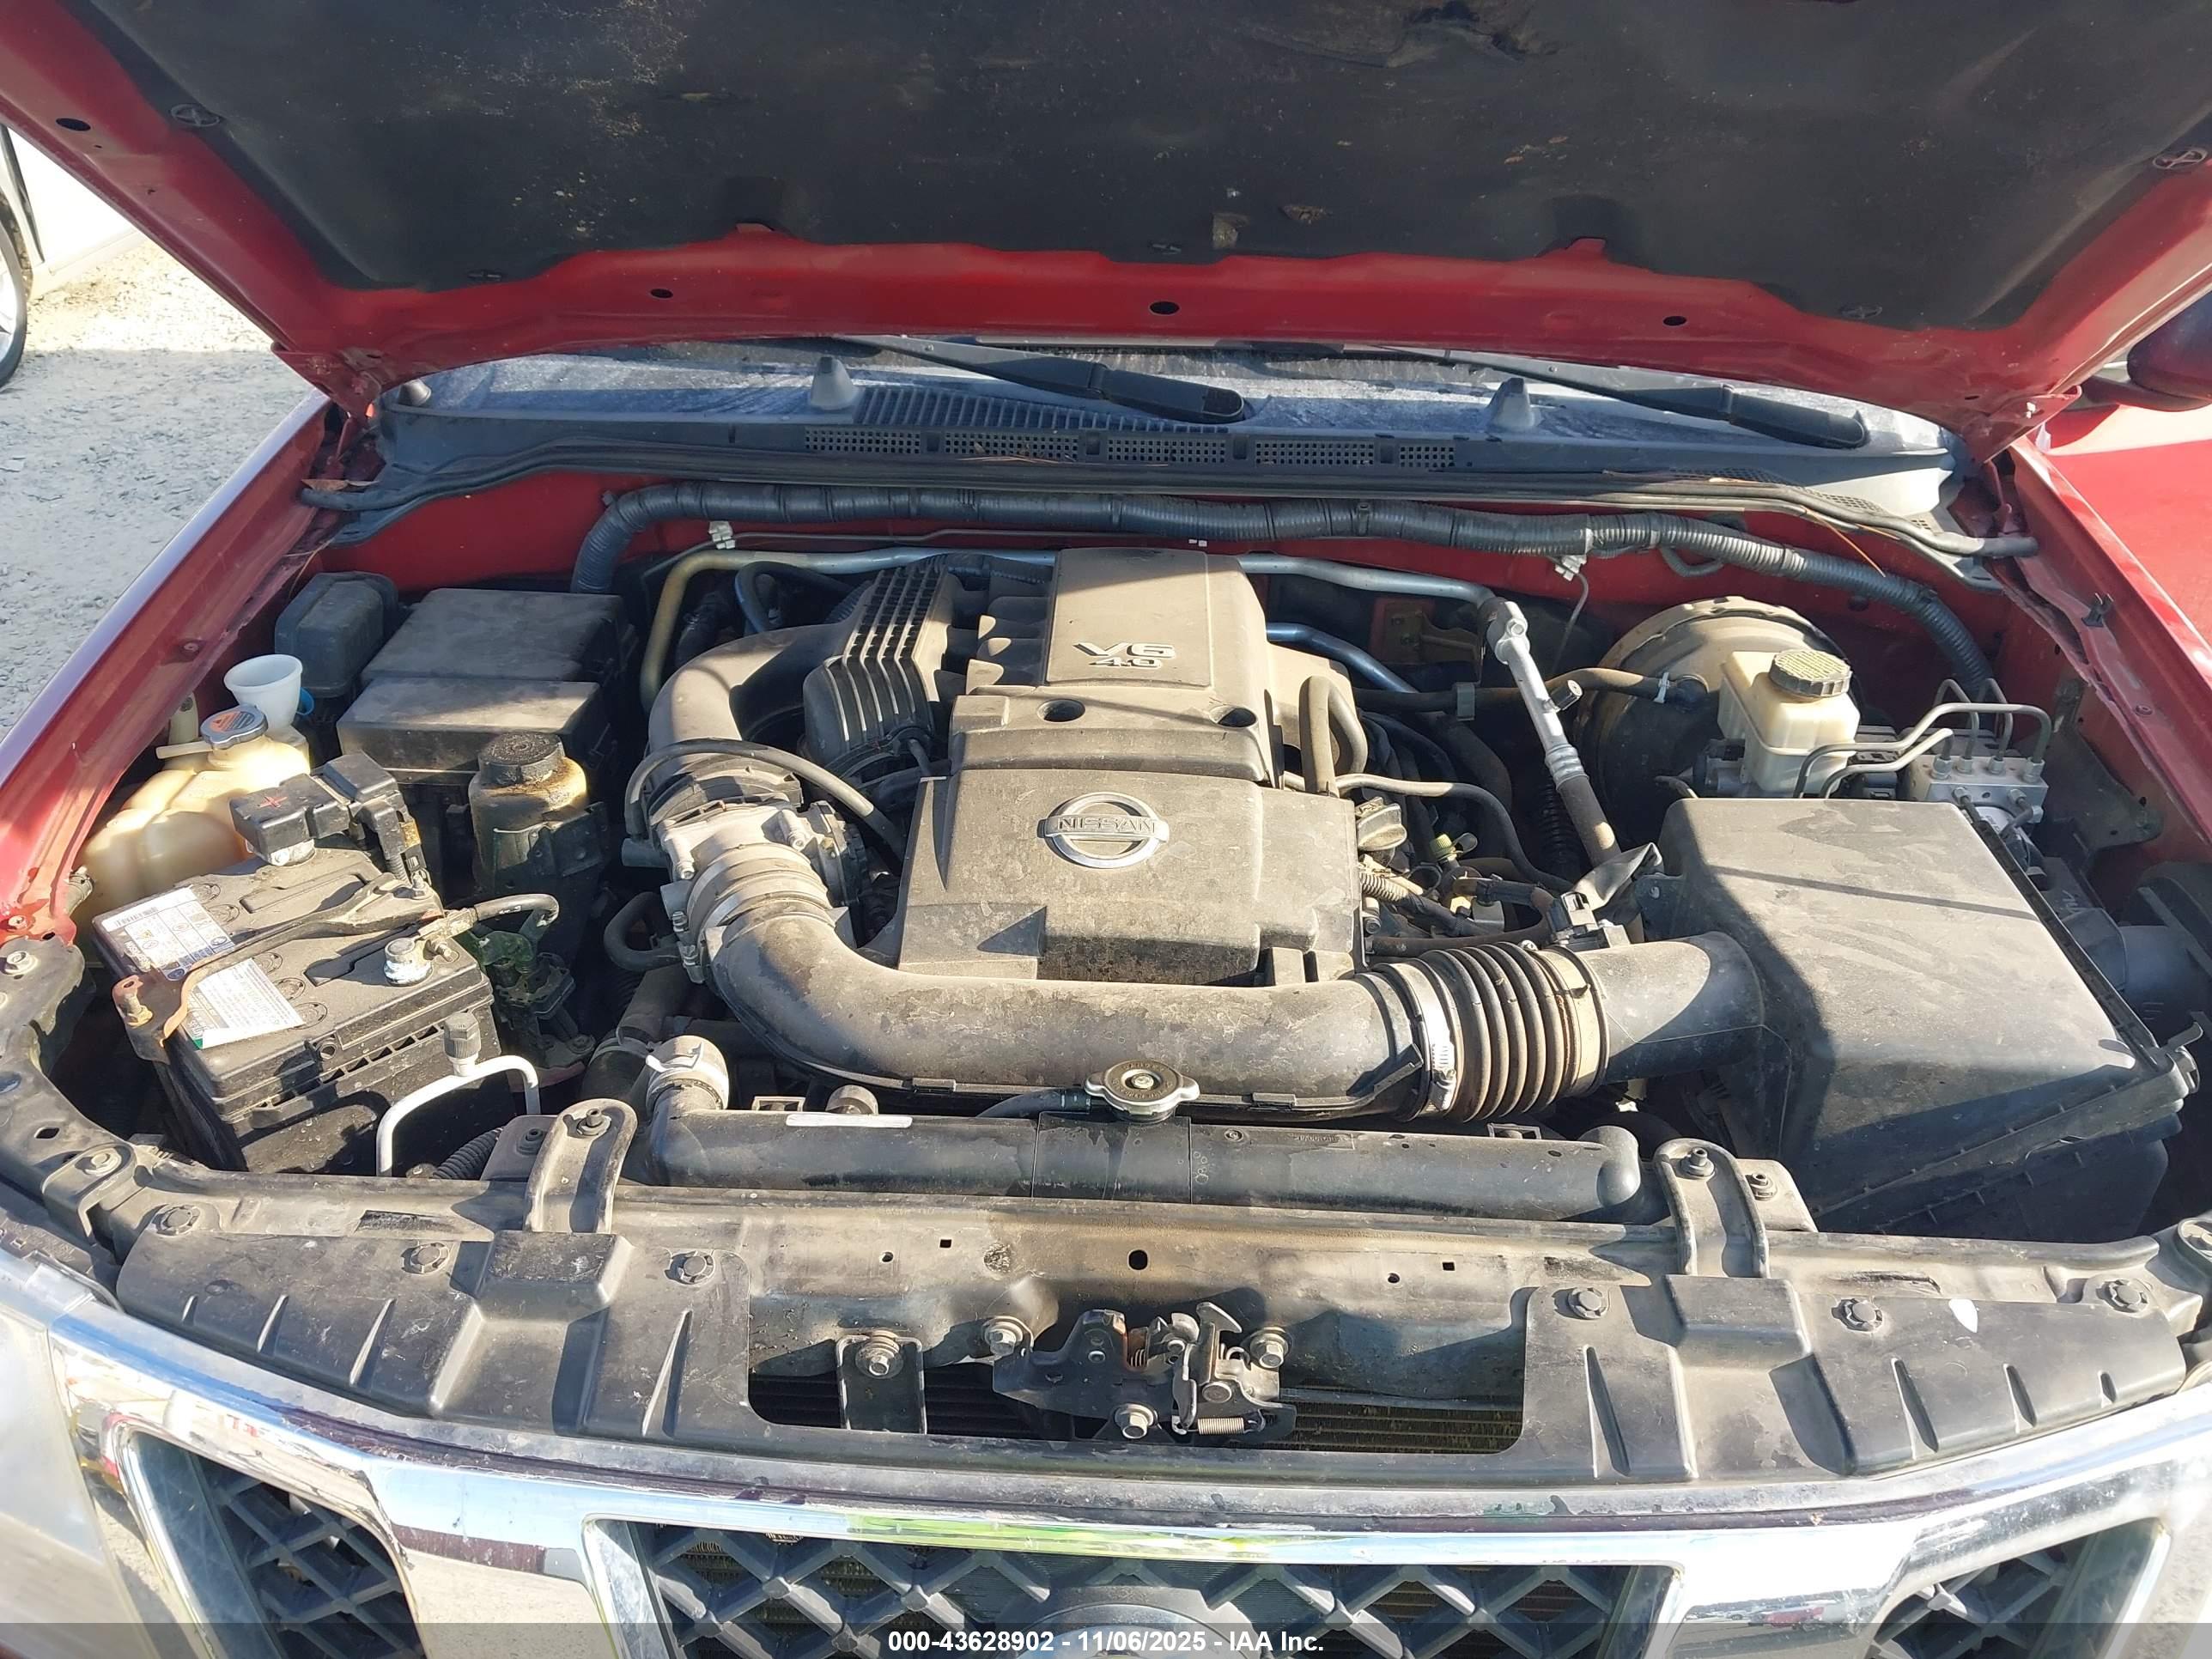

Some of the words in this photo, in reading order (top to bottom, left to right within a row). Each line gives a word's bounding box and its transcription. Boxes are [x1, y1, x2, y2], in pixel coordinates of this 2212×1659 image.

[1073, 642, 1176, 659] V6
[1089, 658, 1163, 668] 4.0
[1057, 817, 1156, 835] NISSAN
